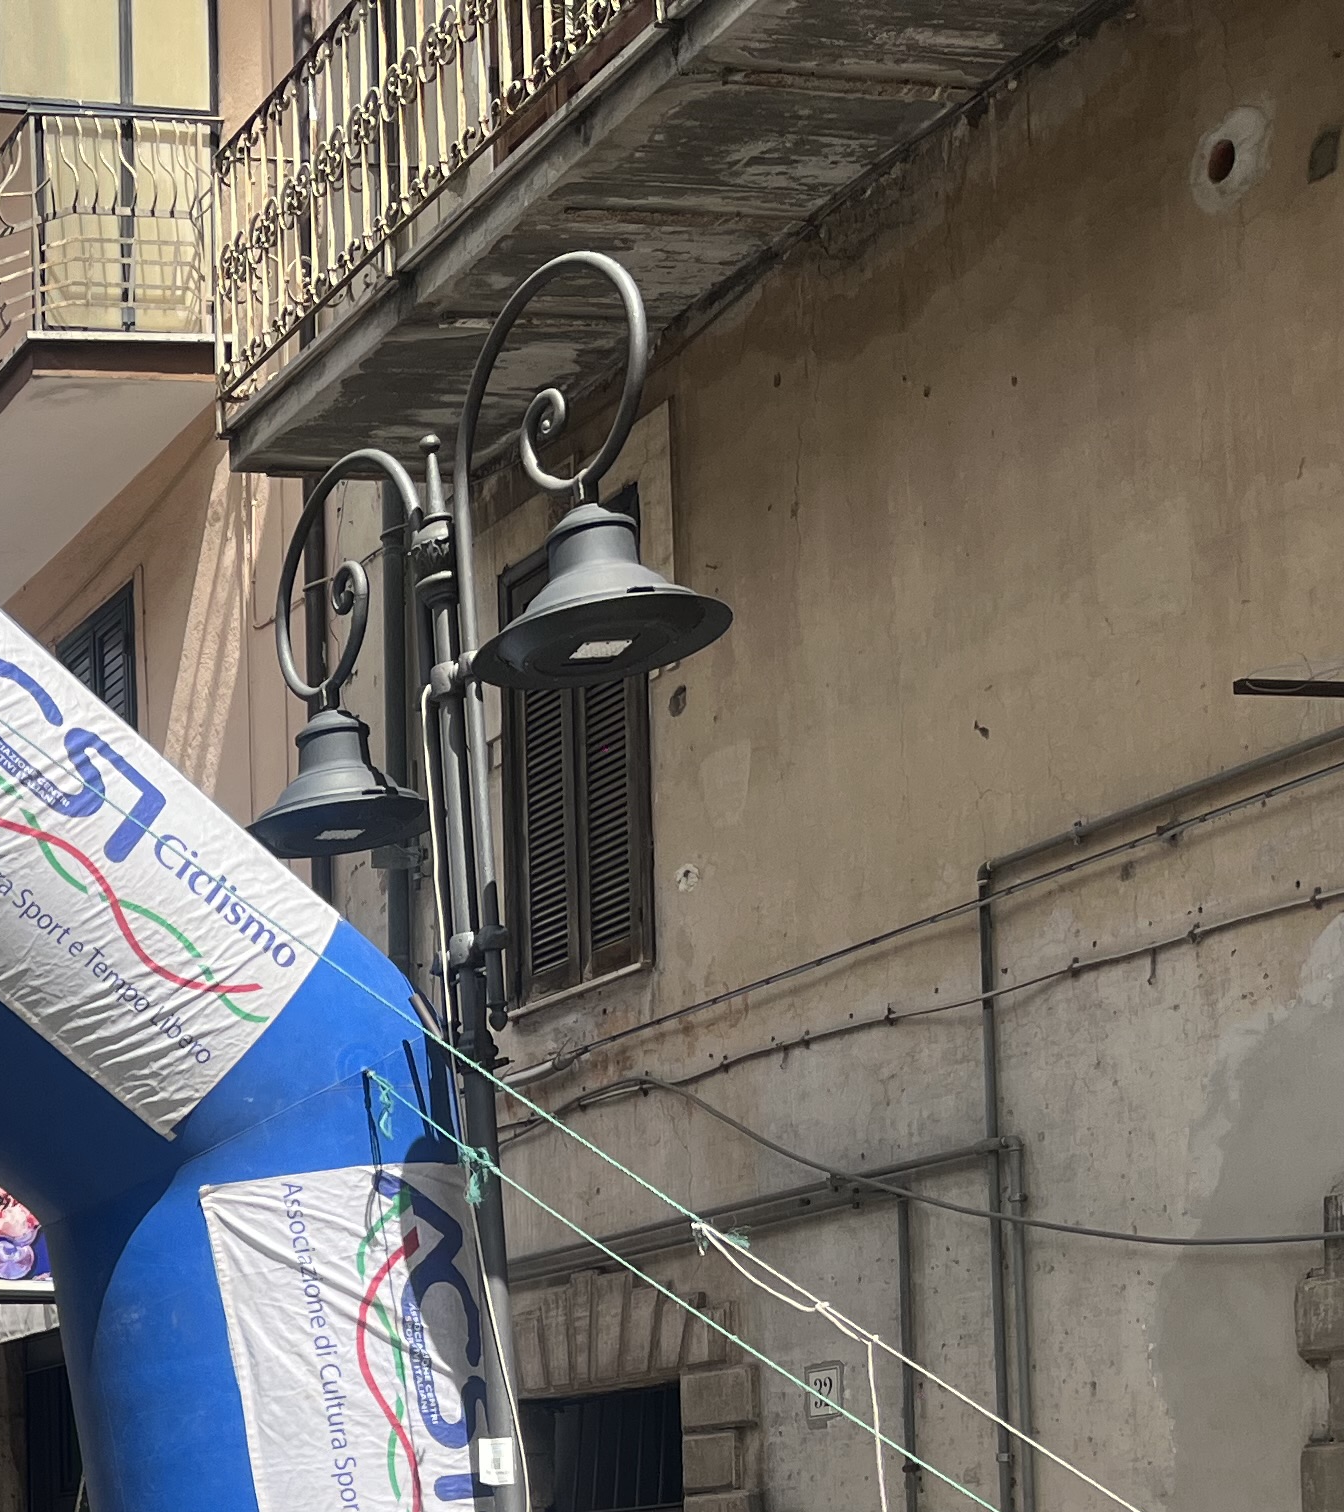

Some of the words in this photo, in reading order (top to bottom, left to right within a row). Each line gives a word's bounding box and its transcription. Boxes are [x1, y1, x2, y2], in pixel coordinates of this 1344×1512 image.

[154, 834, 297, 969] Ciclismo
[11, 886, 72, 949] Sport
[68, 940, 85, 957] e
[82, 946, 153, 1016] Tempo
[148, 1004, 213, 1066] Libero
[282, 1181, 327, 1332] Associazione
[313, 1333, 334, 1358] di
[813, 1376, 833, 1409] 32
[317, 1361, 348, 1451] Cultura
